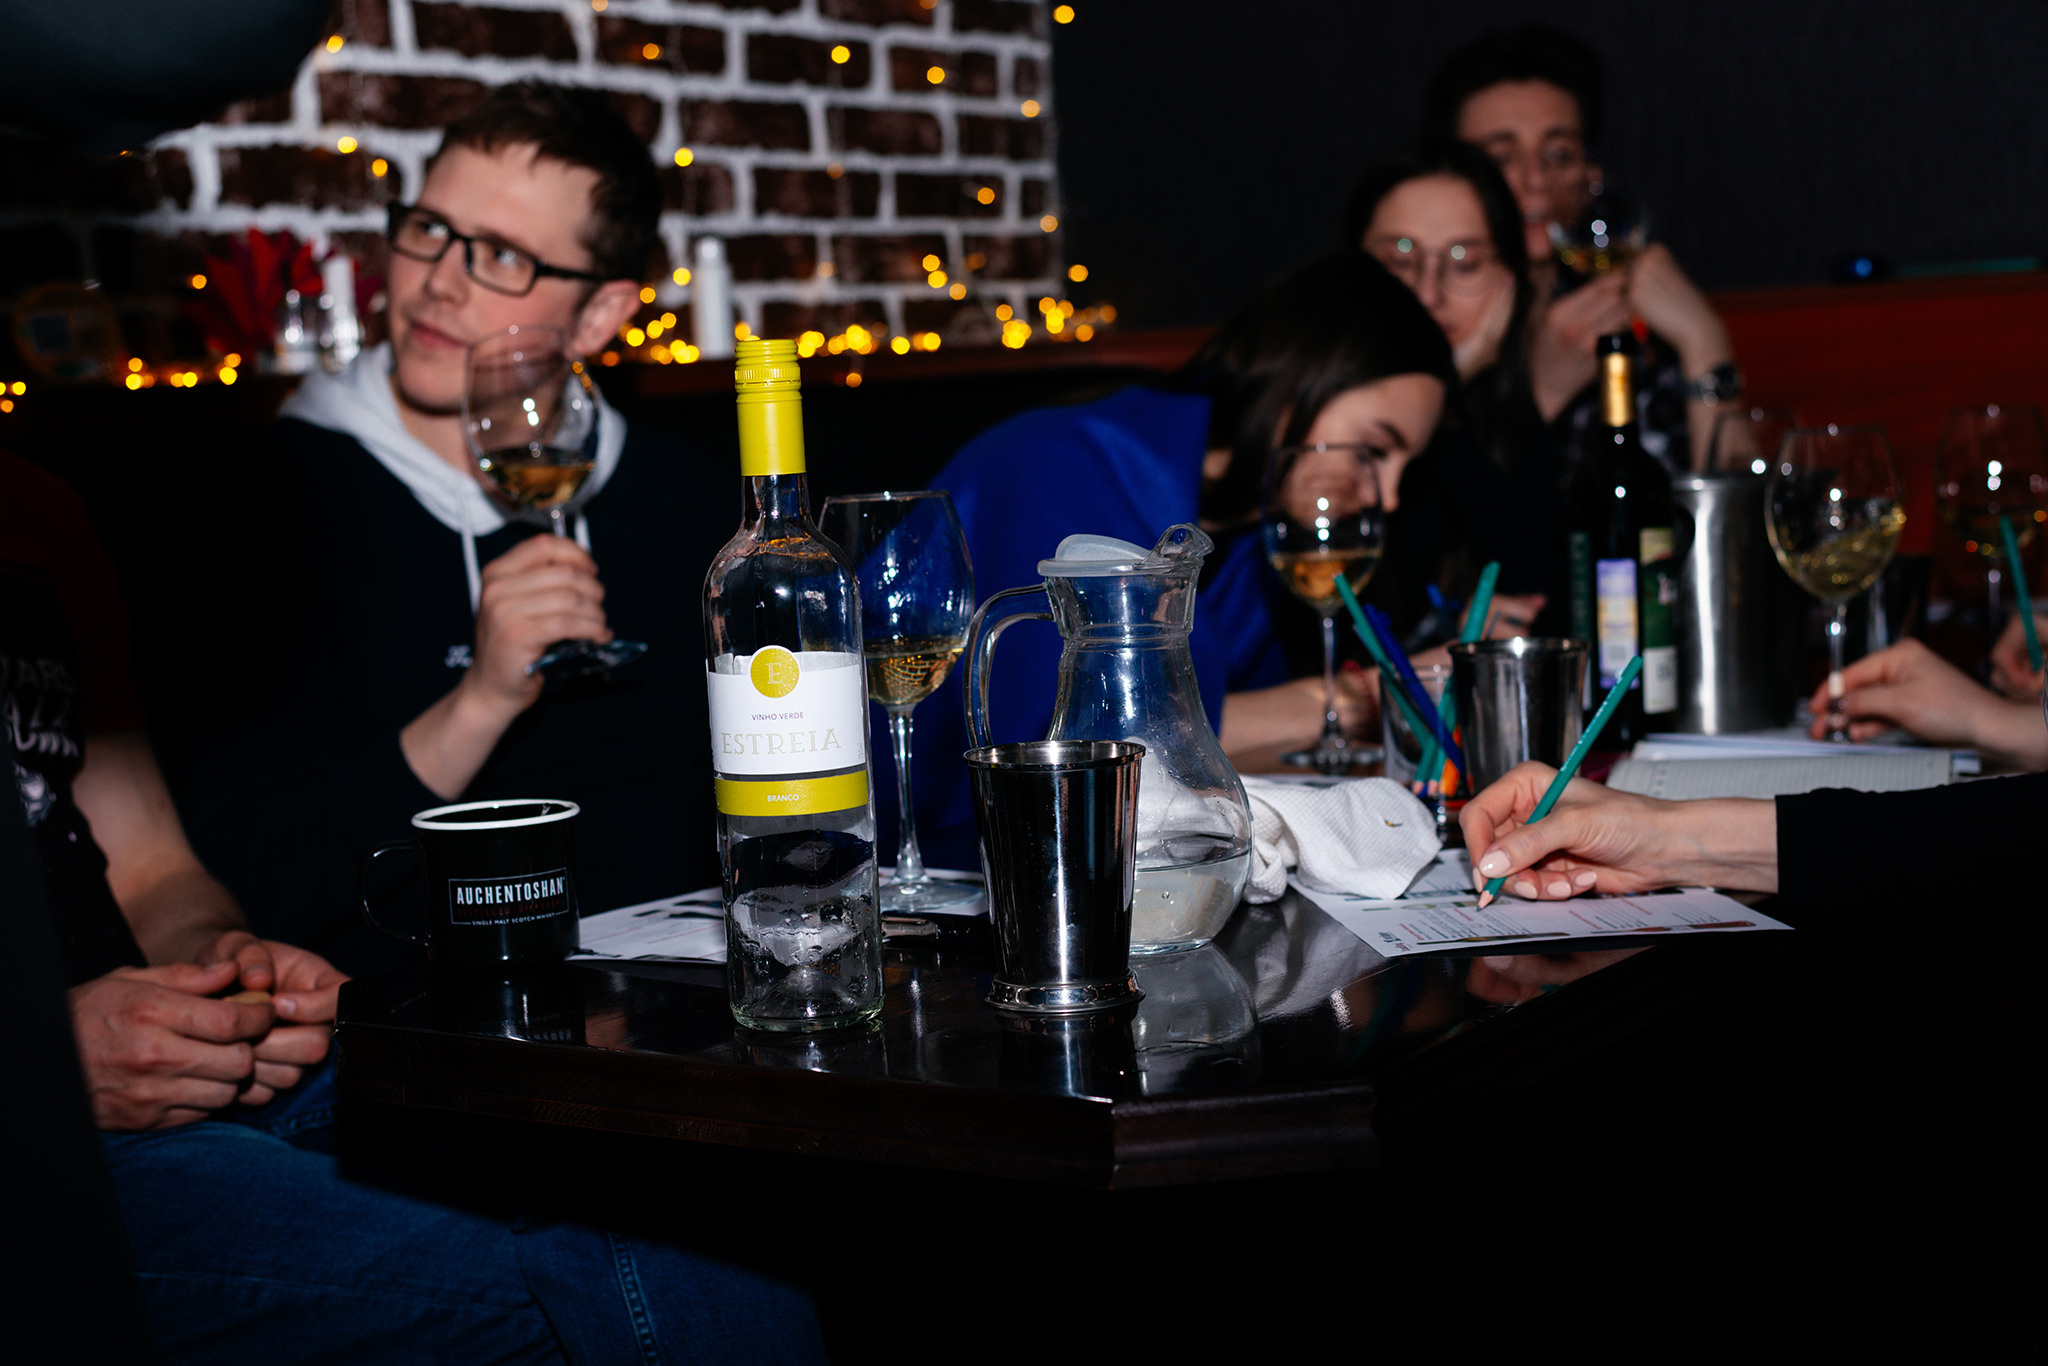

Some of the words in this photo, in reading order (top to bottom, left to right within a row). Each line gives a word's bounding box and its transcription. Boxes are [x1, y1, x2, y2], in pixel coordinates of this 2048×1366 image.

[766, 662, 783, 685] E
[751, 712, 778, 721] VINHO
[779, 711, 804, 721] VERDE
[721, 728, 842, 755] ESTREIA
[766, 793, 800, 803] BRANCO
[456, 877, 565, 905] AUCHENTOSHAN
[472, 919, 493, 927] SINGLE
[494, 918, 510, 926] MALT
[511, 915, 536, 925] SCOTCH
